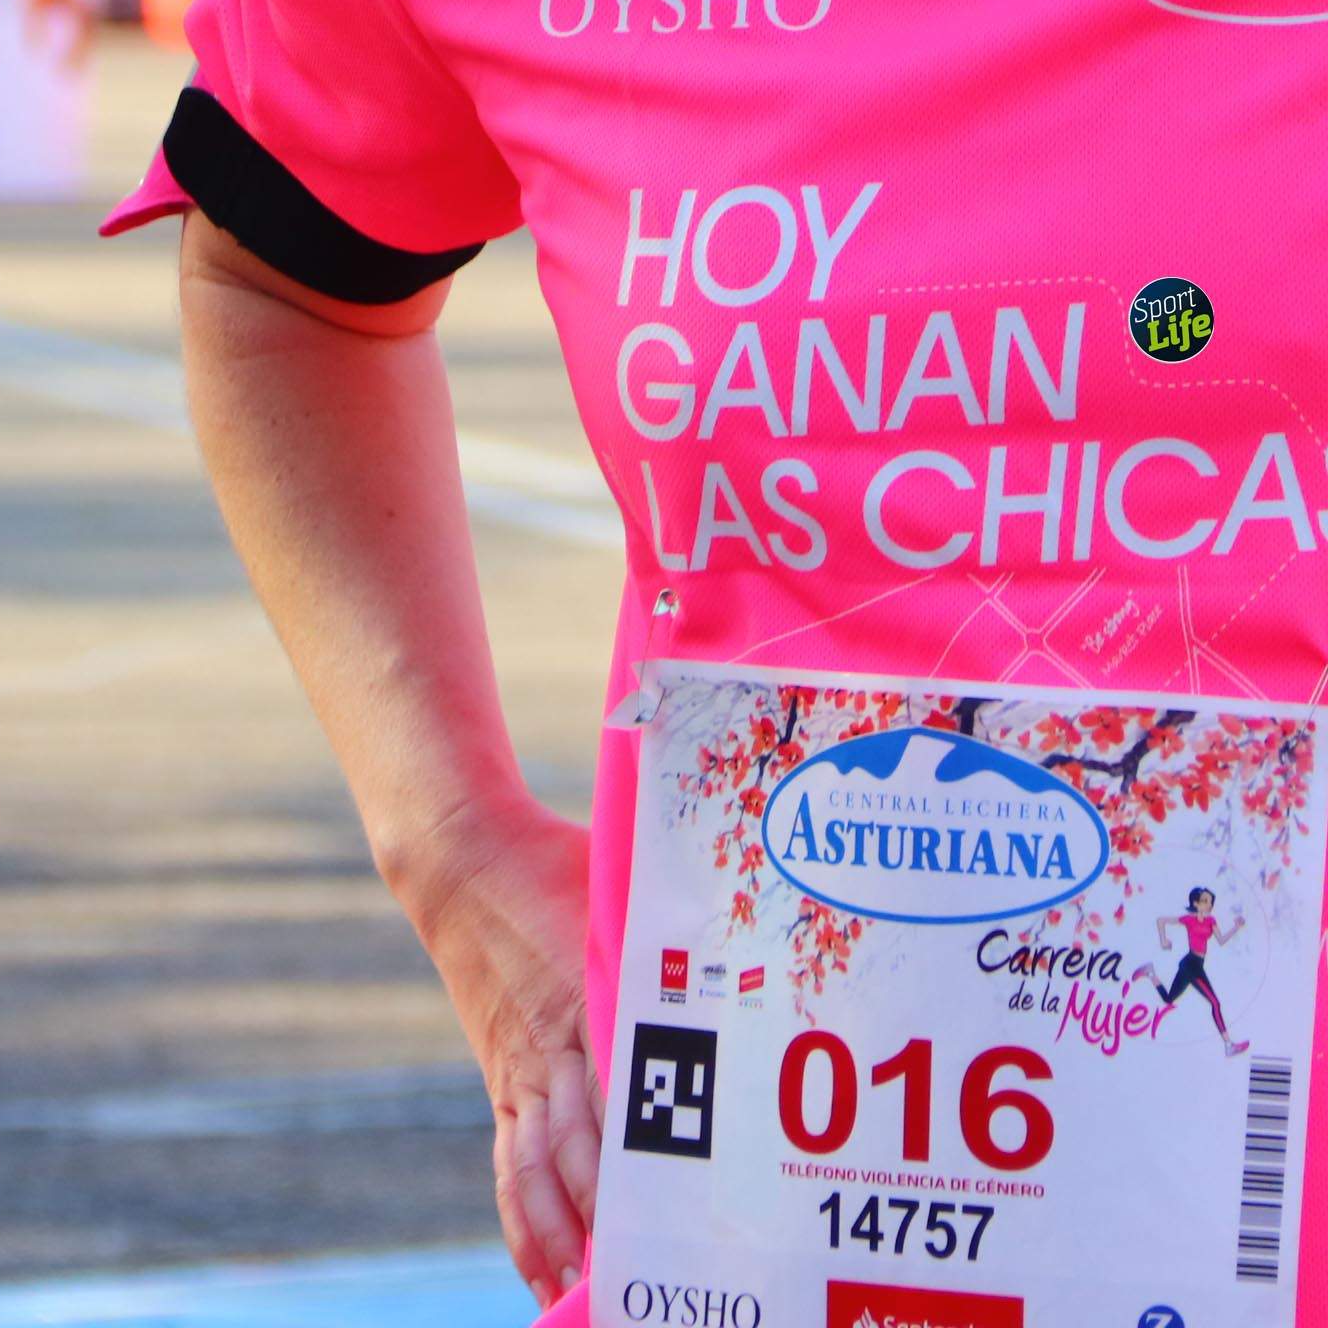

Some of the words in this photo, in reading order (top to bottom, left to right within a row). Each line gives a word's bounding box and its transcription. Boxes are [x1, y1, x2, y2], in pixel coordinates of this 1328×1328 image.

[616, 182, 881, 308] HOY
[1134, 286, 1197, 323] Sport
[1147, 309, 1211, 352] Life
[616, 302, 1085, 442] GANAN
[640, 458, 827, 572] LAS
[782, 792, 1076, 880] ASTURIANA
[829, 789, 931, 813] CENTRAL
[945, 799, 1066, 822] LECHERA
[976, 930, 1123, 982] Carrera
[1008, 980, 1034, 1012] de
[1041, 982, 1059, 1013] la
[1056, 980, 1177, 1056] Mujer
[778, 1029, 1054, 1171] 016
[779, 1161, 857, 1182] TELÉFONO
[861, 1170, 945, 1191] VIOLENCIA
[951, 1177, 970, 1192] DE
[975, 1178, 1045, 1199] GÉNERO
[819, 1191, 995, 1260] 14757
[623, 1280, 761, 1328] OYSHO
